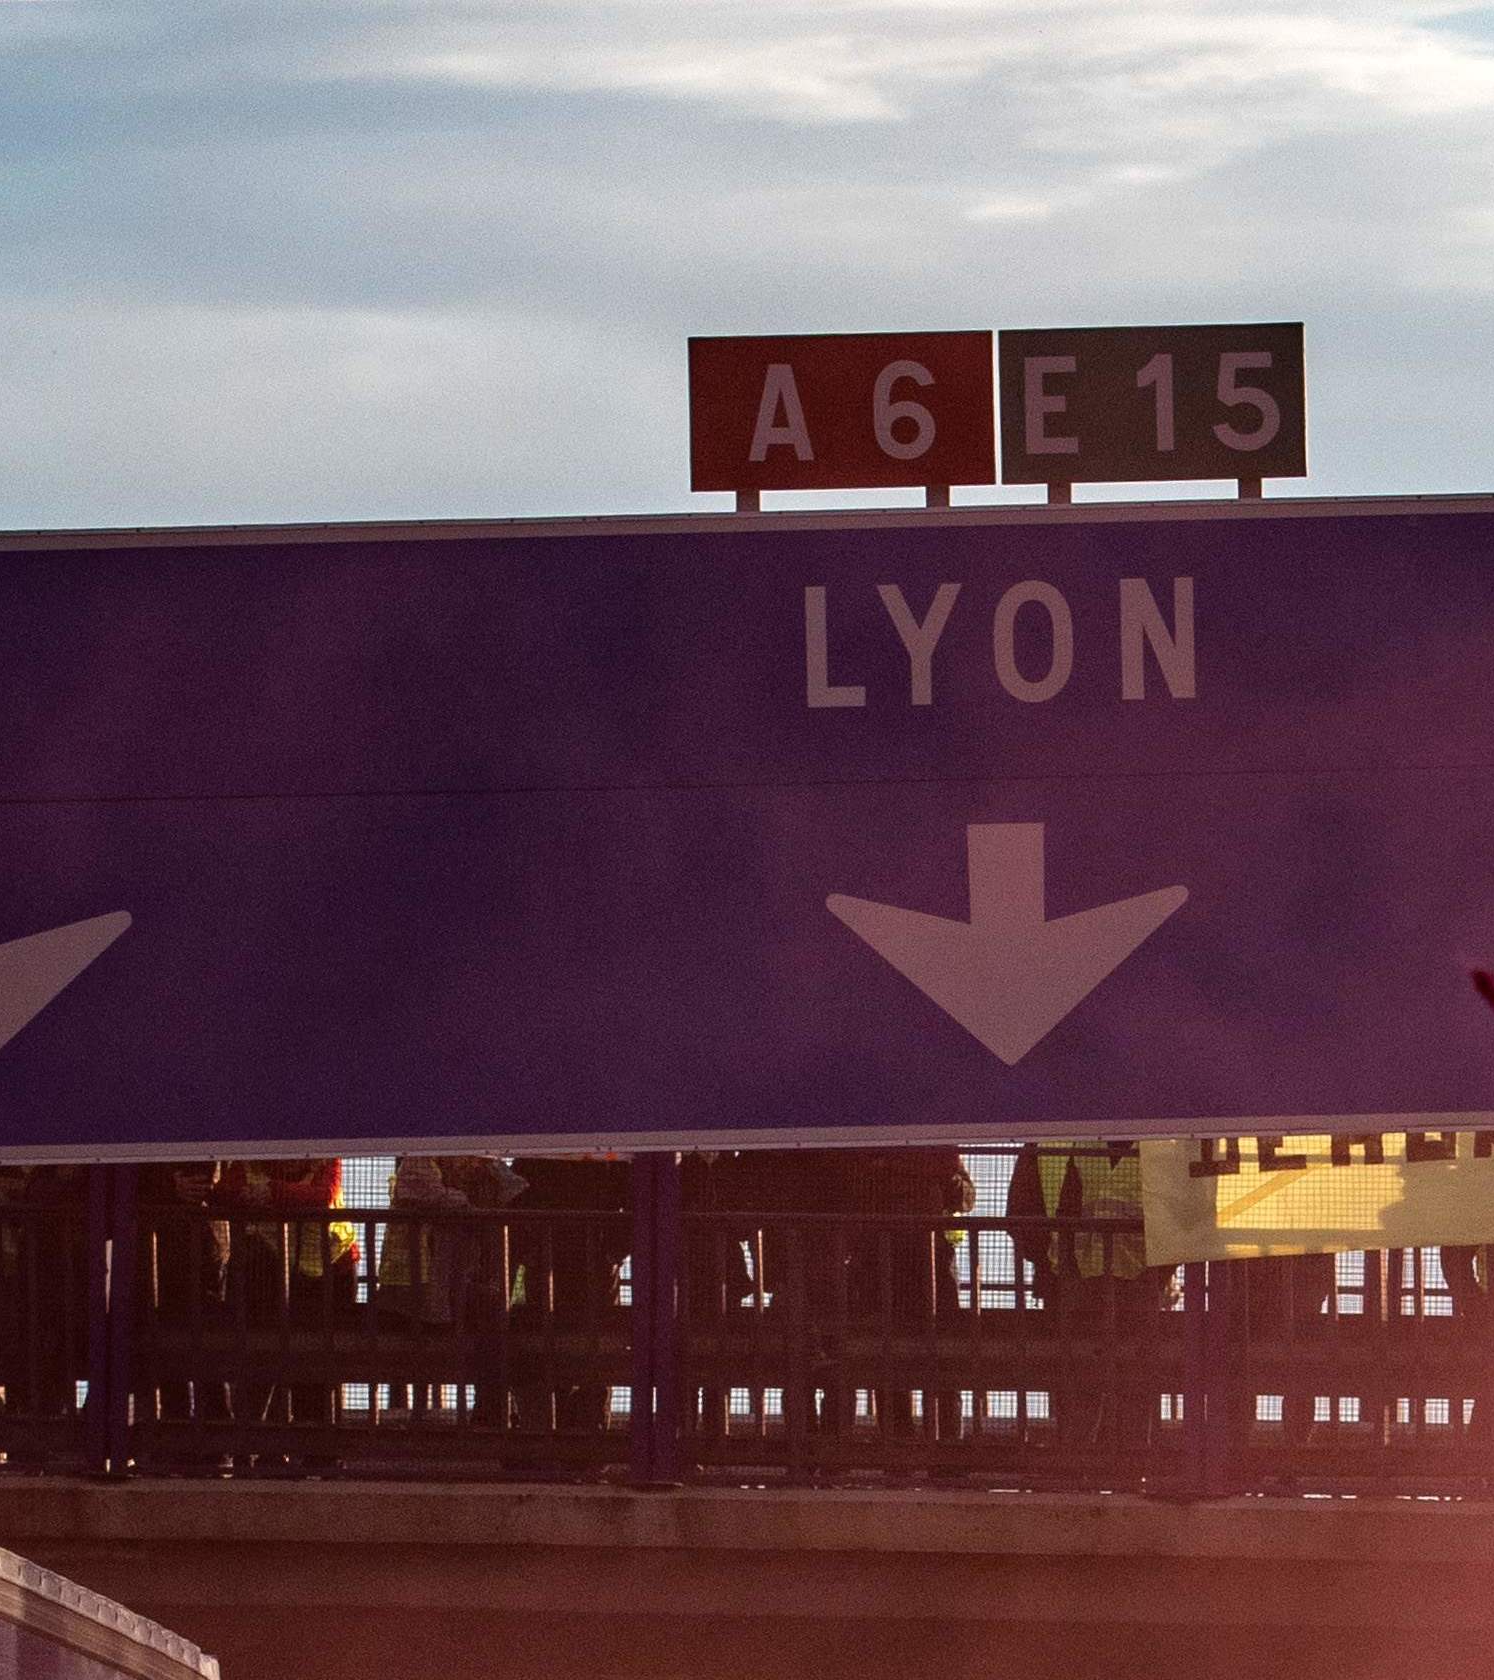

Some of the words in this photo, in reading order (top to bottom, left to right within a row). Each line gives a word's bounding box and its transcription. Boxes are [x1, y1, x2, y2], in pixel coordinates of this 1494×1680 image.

[748, 363, 814, 462] A
[872, 359, 936, 460] 6
[1023, 355, 1079, 455] E
[1135, 350, 1281, 452] 15
[804, 576, 1197, 709] LYON
